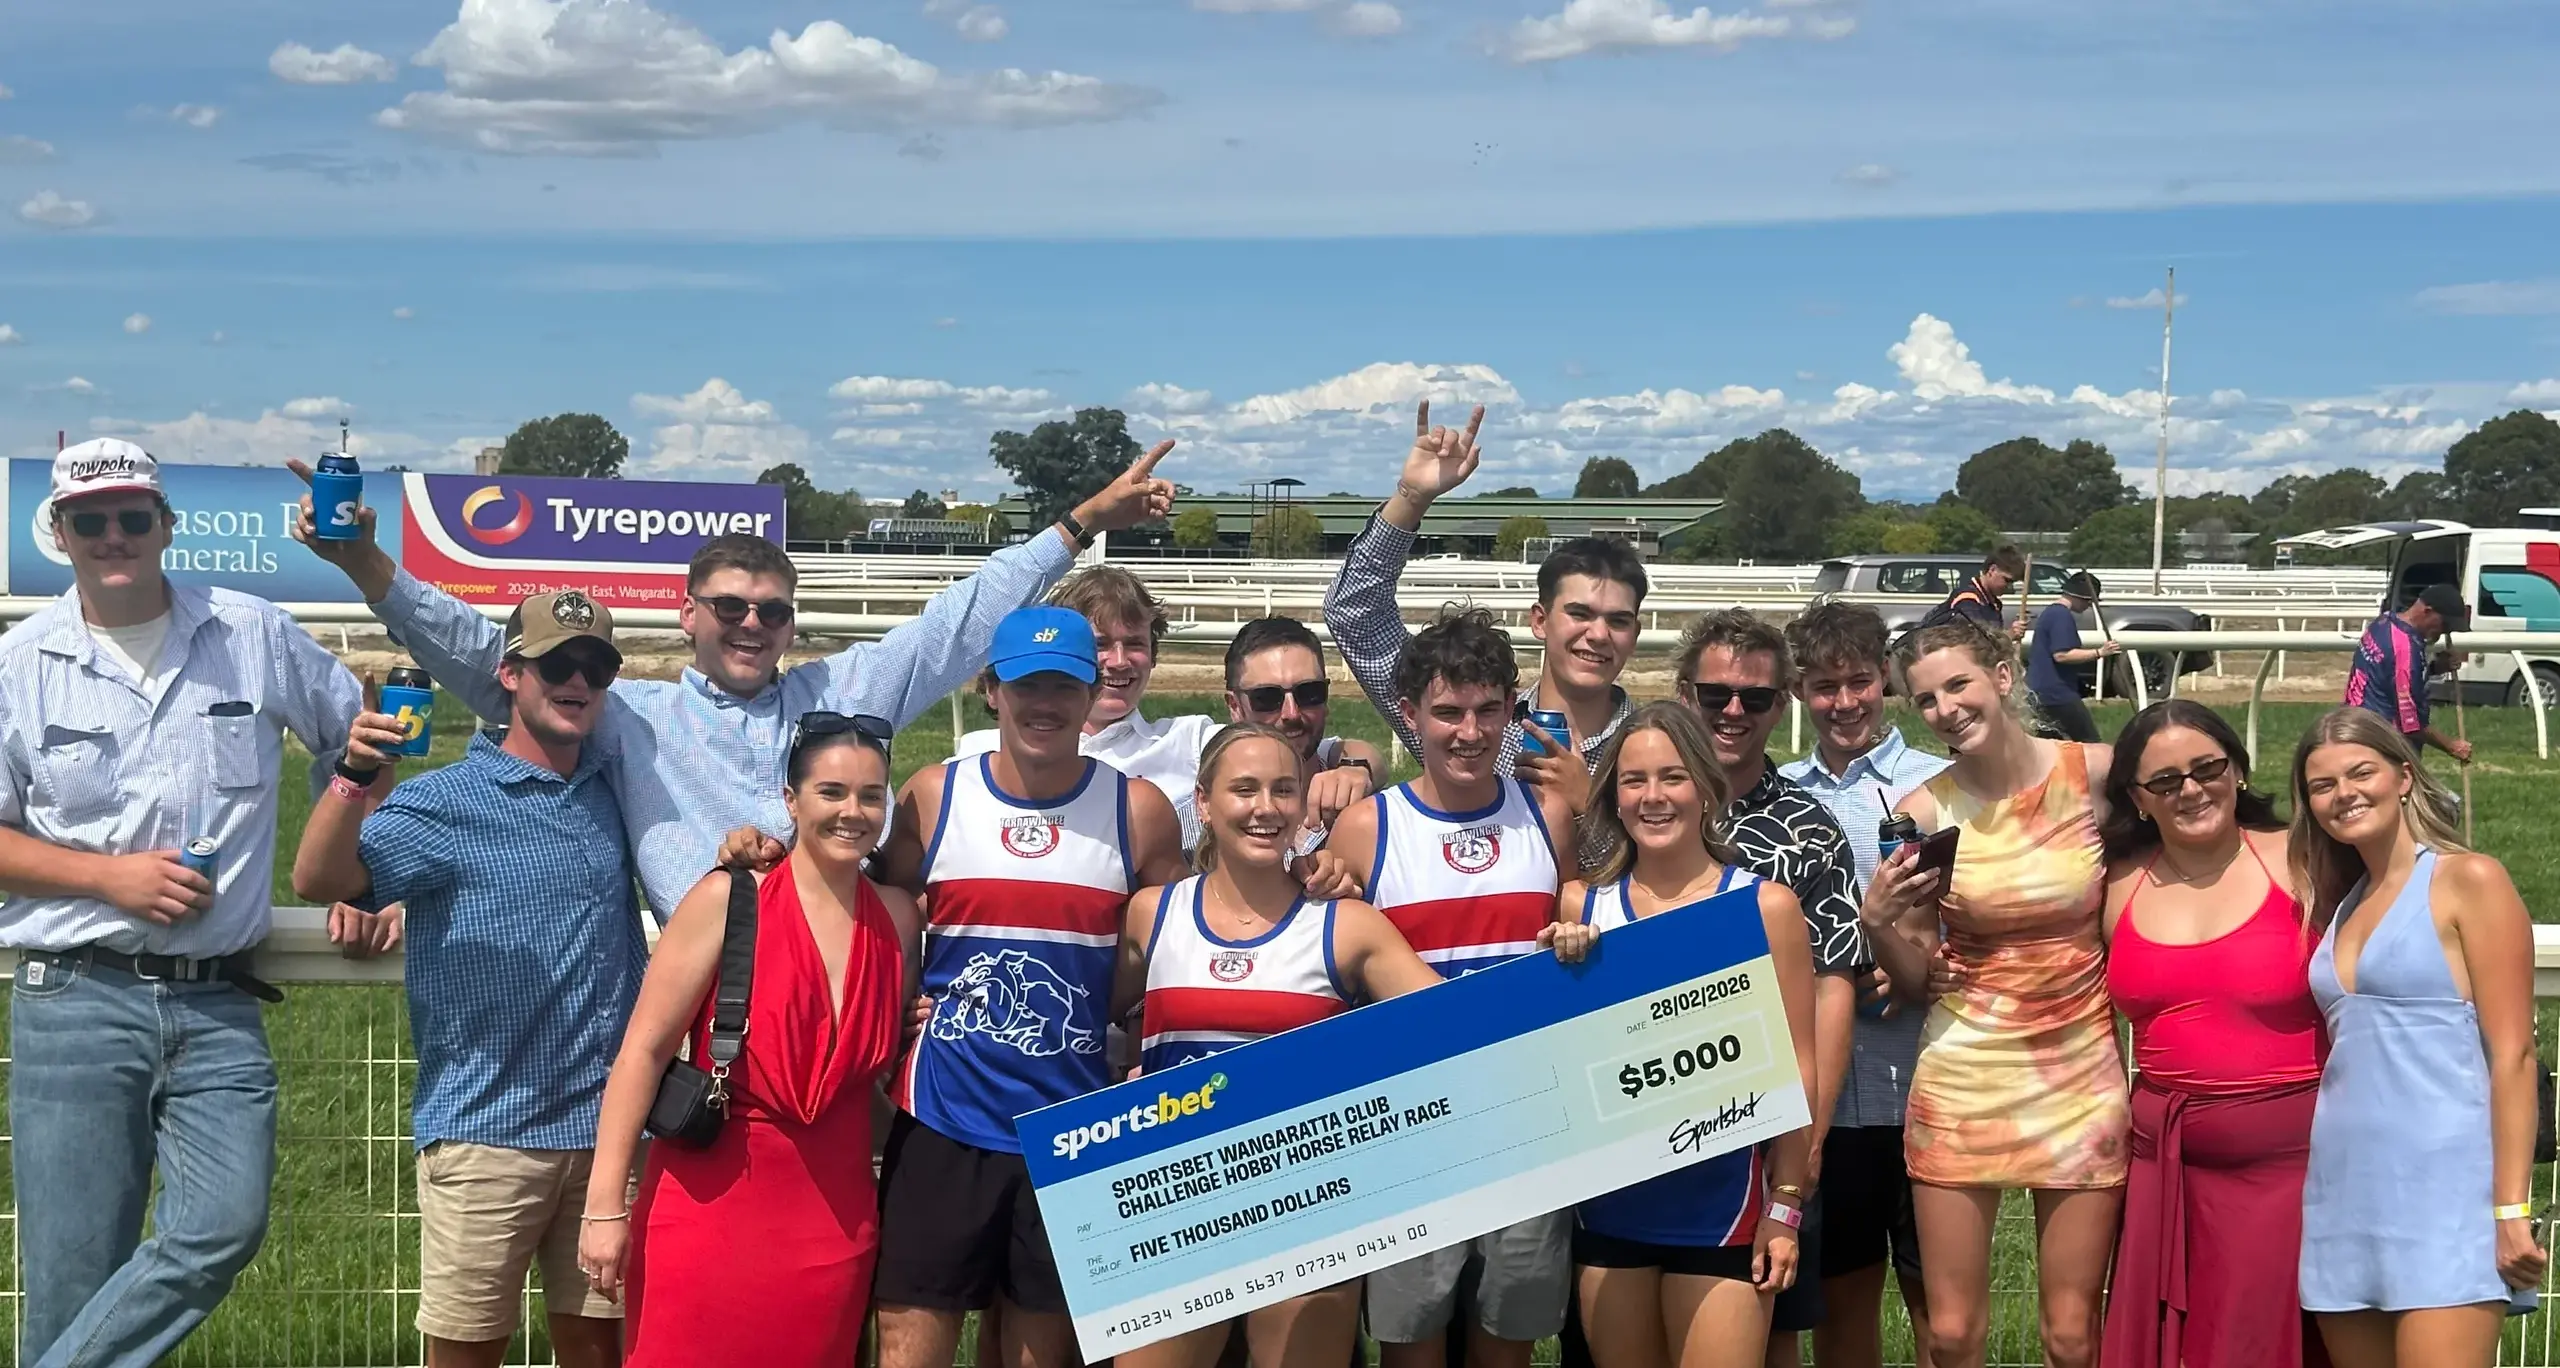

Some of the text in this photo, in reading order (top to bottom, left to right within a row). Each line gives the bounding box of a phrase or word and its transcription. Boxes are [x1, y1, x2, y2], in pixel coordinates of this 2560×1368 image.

[71, 455, 135, 480] Cowpoke
[172, 509, 267, 538] ason
[547, 498, 772, 543] Tyrepower
[161, 540, 278, 574] nerals
[507, 583, 537, 595] 20-22
[592, 586, 616, 598] East,
[619, 585, 677, 602] Wangaratta
[1032, 627, 1054, 642] sb
[1626, 973, 1751, 1034] DATE 28/02/2026
[1618, 1034, 1741, 1099] $5,000
[1053, 1083, 1216, 1160] sportsbet
[1668, 1091, 1766, 1154] Sportsbet
[1112, 1095, 1391, 1199] SPORTSBET WANGARATTA CLUB
[1118, 1097, 1452, 1219] CHALLENGE HOBBY HORSE RELAY RACE
[1076, 1222, 1092, 1234] PAY
[1129, 1177, 1352, 1263] FIVE THOUSAND DOLLARS
[1086, 1254, 1104, 1267] THE
[1089, 1259, 1122, 1277] SUM OF
[1120, 1223, 1428, 1335] 01234 58008 5637 07734 0414 00
